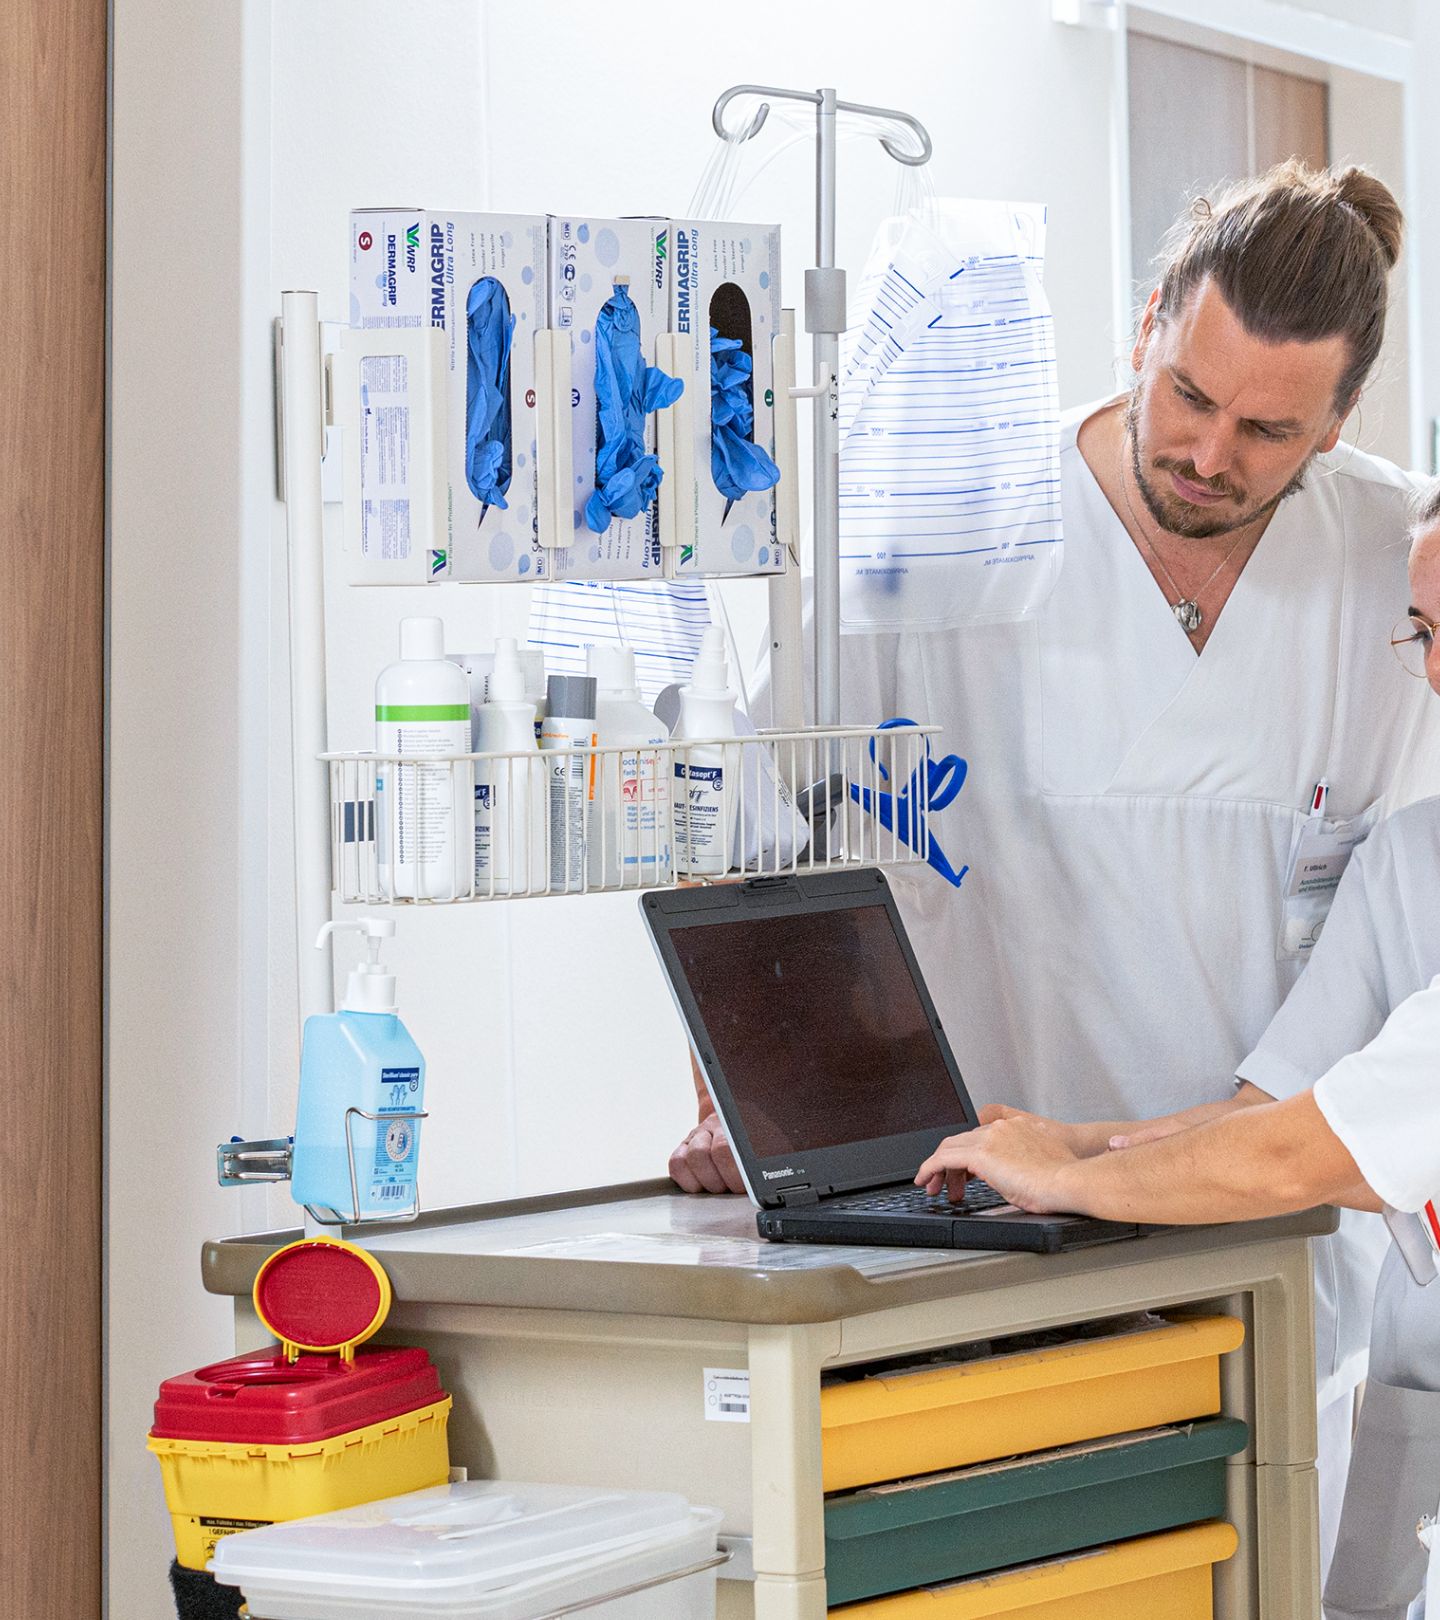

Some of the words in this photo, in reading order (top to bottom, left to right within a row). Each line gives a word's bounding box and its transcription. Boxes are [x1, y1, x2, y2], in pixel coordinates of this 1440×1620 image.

[445, 222, 454, 252] Long
[690, 228, 699, 258] Long
[388, 234, 396, 306] DERMAGRIP
[407, 244, 416, 273] WRP
[445, 256, 454, 284] Ultra
[431, 223, 445, 330] ERMAGRIP
[677, 230, 690, 334] ERMAGRIP
[690, 261, 699, 288] Ultra
[642, 539, 651, 568] Long
[762, 1166, 794, 1180] Panasonic
